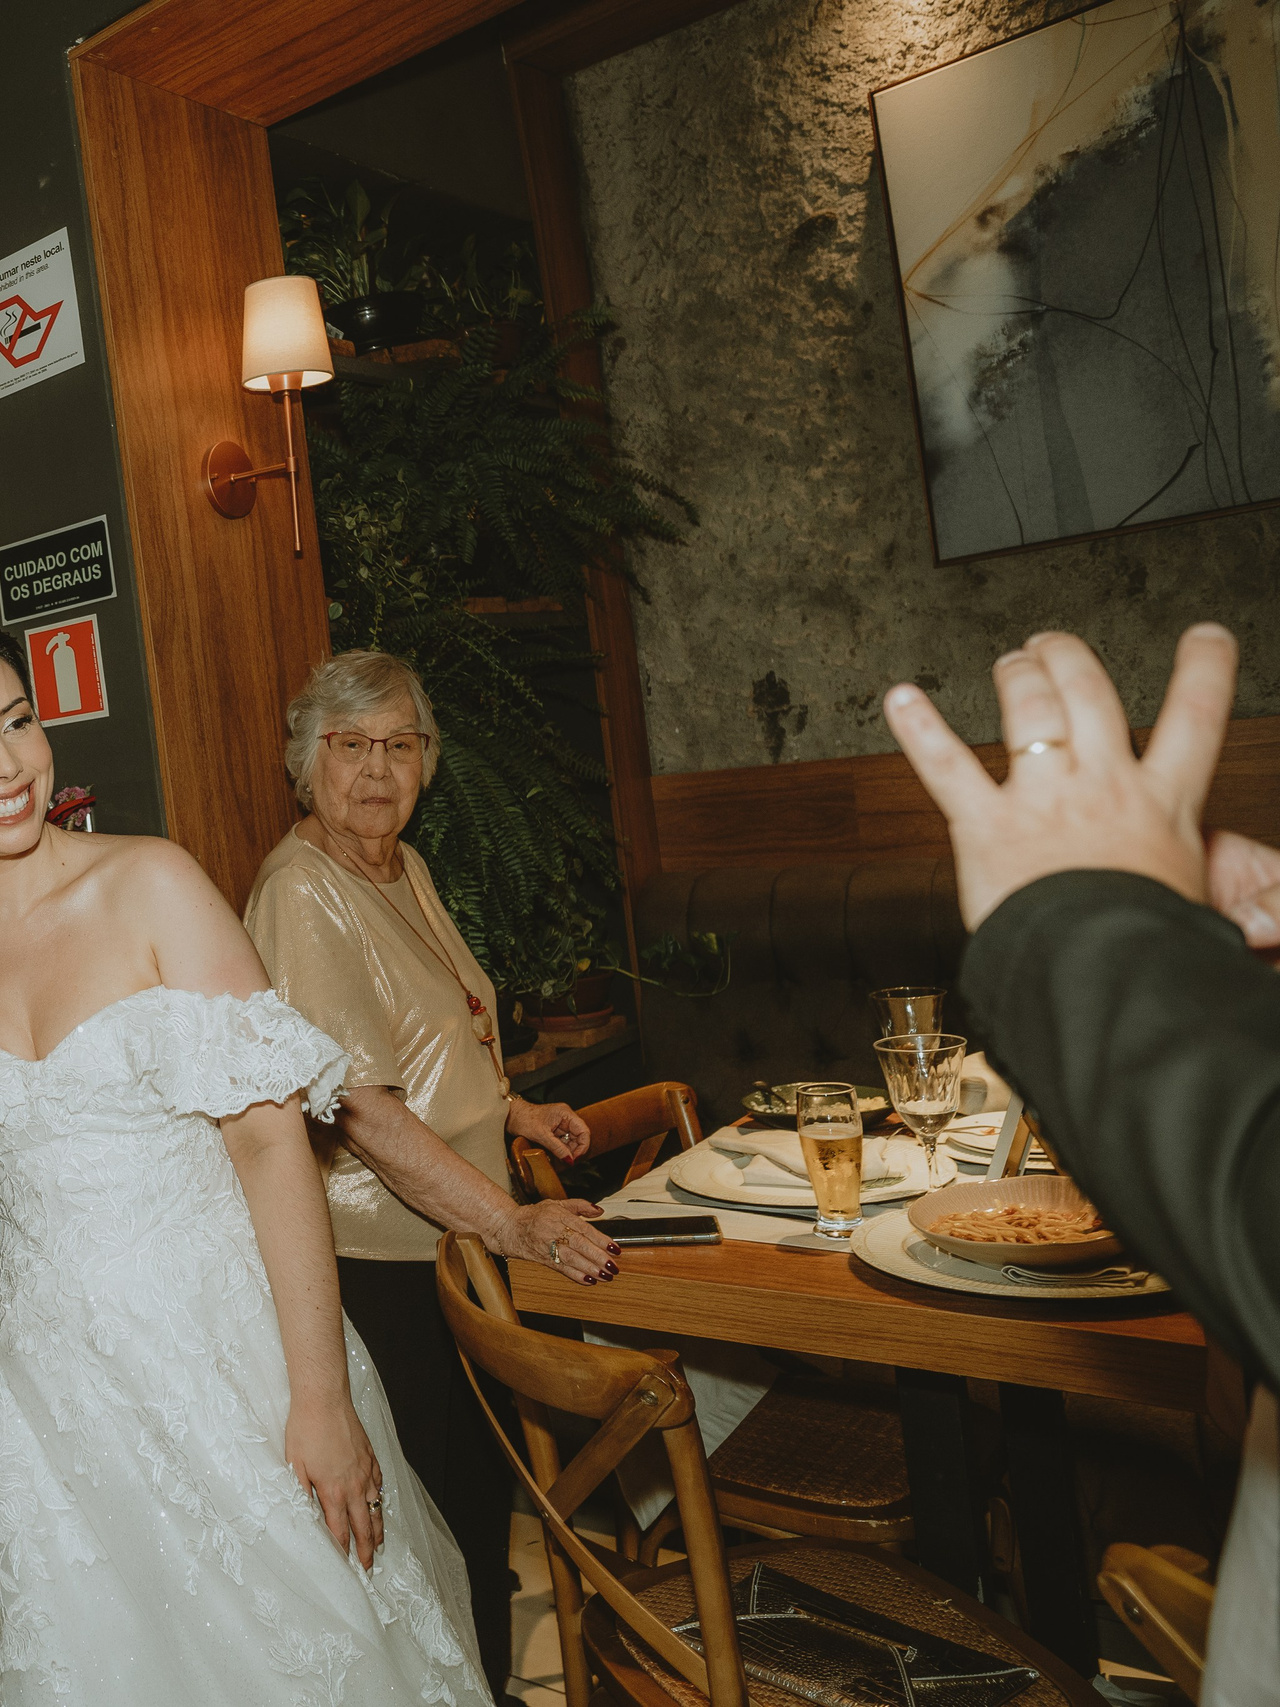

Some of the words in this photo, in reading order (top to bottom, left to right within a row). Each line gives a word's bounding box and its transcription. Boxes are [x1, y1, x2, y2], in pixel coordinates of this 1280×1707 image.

[20, 254, 42, 271] neste
[43, 241, 65, 259] local.
[19, 274, 25, 283] in
[25, 269, 35, 280] this
[4, 552, 66, 581] CUIDADO
[70, 540, 103, 563] COM
[10, 583, 30, 601] OS
[33, 564, 102, 596] DEGRAUS
